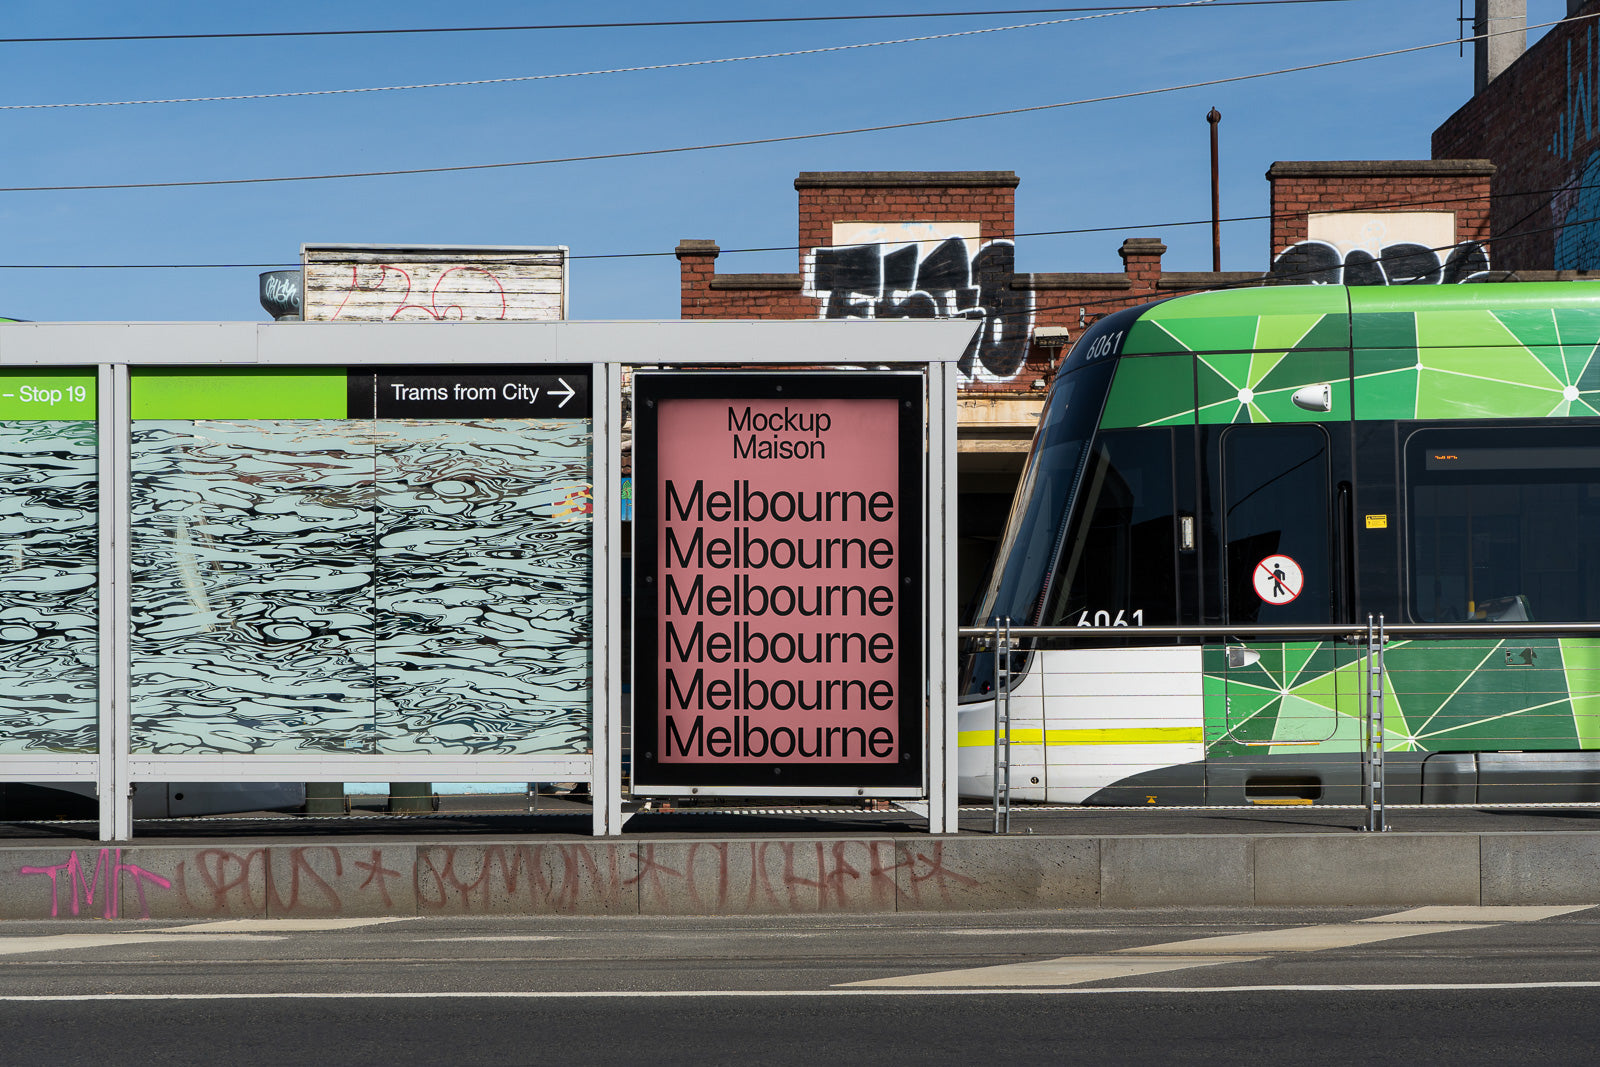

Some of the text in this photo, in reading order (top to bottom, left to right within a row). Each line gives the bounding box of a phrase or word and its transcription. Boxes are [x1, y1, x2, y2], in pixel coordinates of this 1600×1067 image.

[1086, 330, 1124, 361] 6061
[20, 385, 62, 406] Stop
[66, 385, 86, 402] 19
[391, 383, 540, 405] Trams from City
[728, 407, 832, 438] Mockup
[733, 434, 825, 460] Maison
[665, 480, 894, 522] Melbourne
[665, 527, 894, 569] Melbourne
[665, 574, 894, 616] Melbourne
[1077, 609, 1143, 627] 6061
[665, 621, 894, 663] Melbourne
[665, 668, 894, 710] Melbourne
[665, 715, 894, 757] Melbourne
